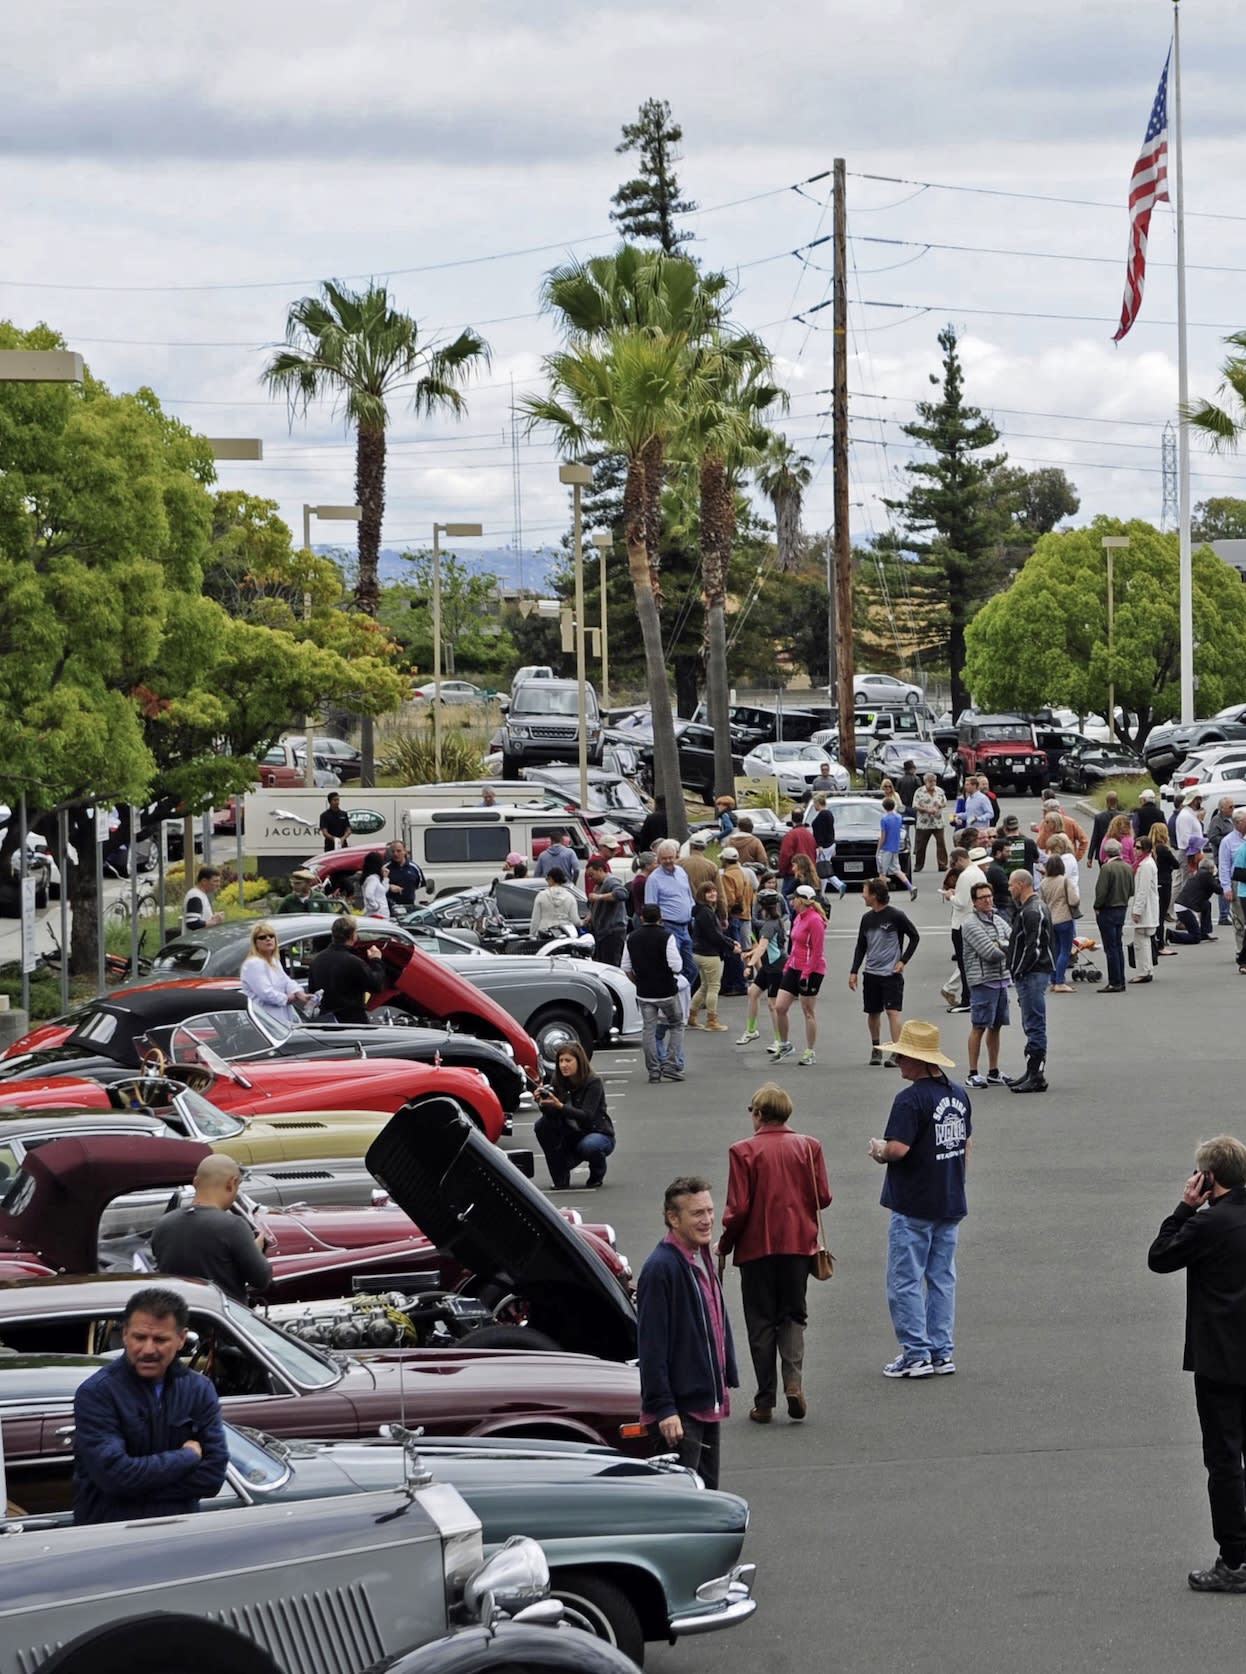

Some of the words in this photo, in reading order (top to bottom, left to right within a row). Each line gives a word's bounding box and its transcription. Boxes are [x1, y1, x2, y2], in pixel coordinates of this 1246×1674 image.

[265, 827, 320, 837] JAGUAR
[933, 1096, 951, 1121] SOUTH
[951, 1097, 967, 1116] SIDE
